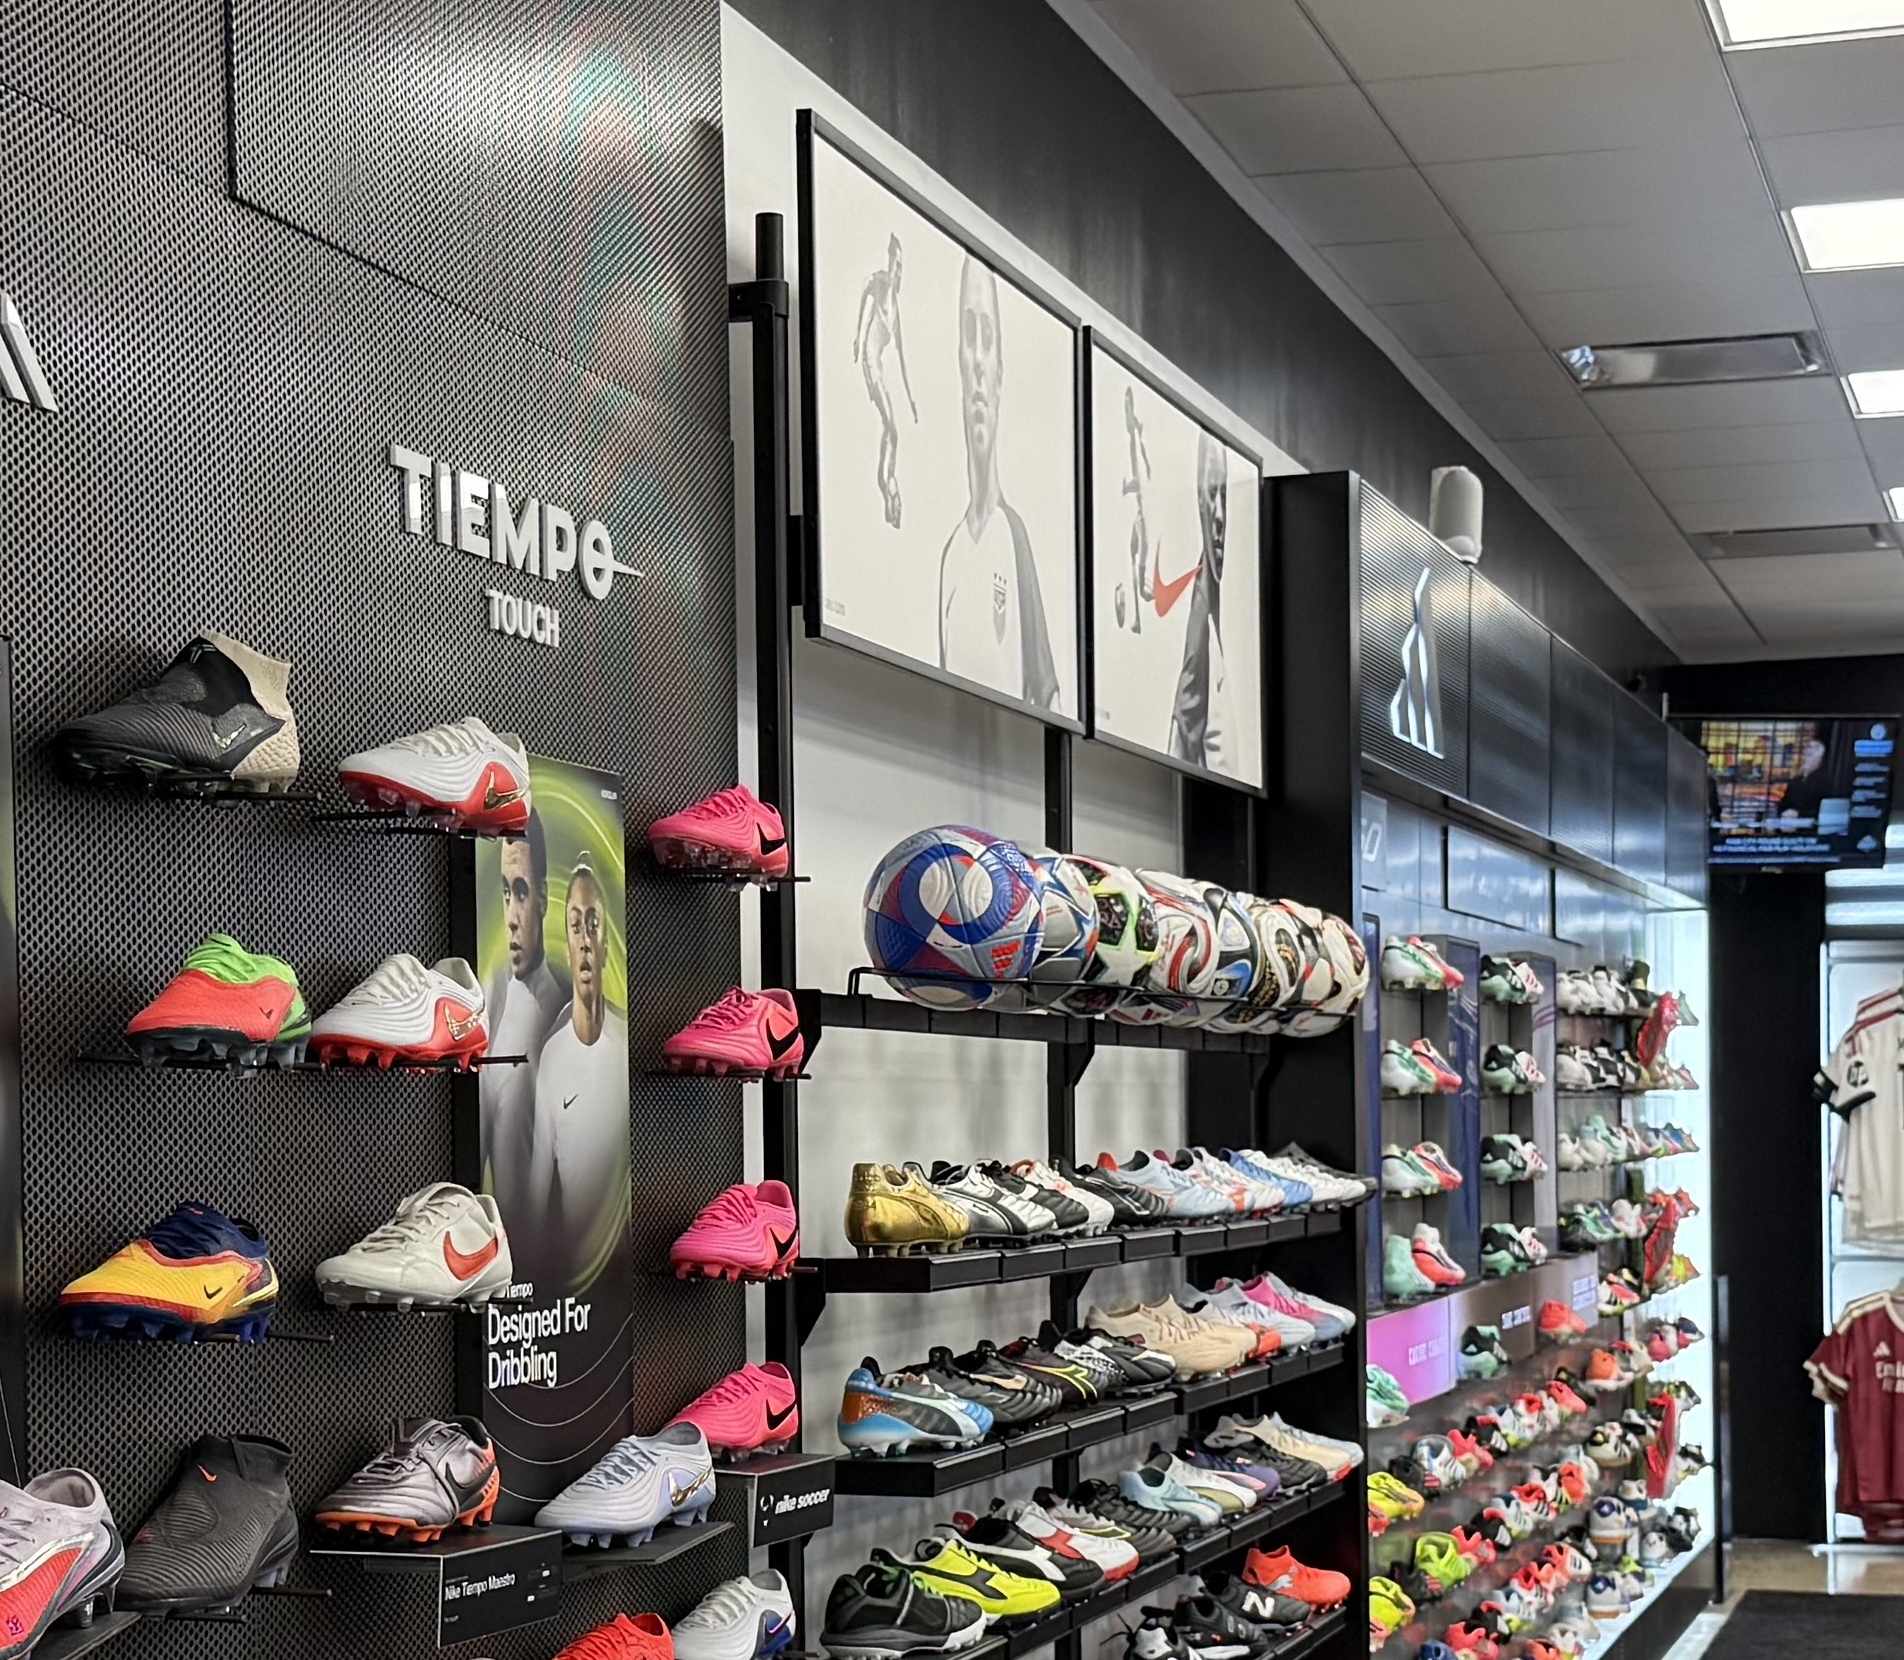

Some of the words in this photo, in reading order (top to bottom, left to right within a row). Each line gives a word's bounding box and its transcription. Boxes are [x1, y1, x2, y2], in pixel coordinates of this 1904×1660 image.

[390, 444, 644, 601] TIEMPO
[485, 588, 559, 648] TOUCH
[488, 1299, 561, 1349] Designed
[564, 1297, 591, 1334] For
[488, 1345, 557, 1390] Dribbling
[797, 1488, 831, 1510] soccer
